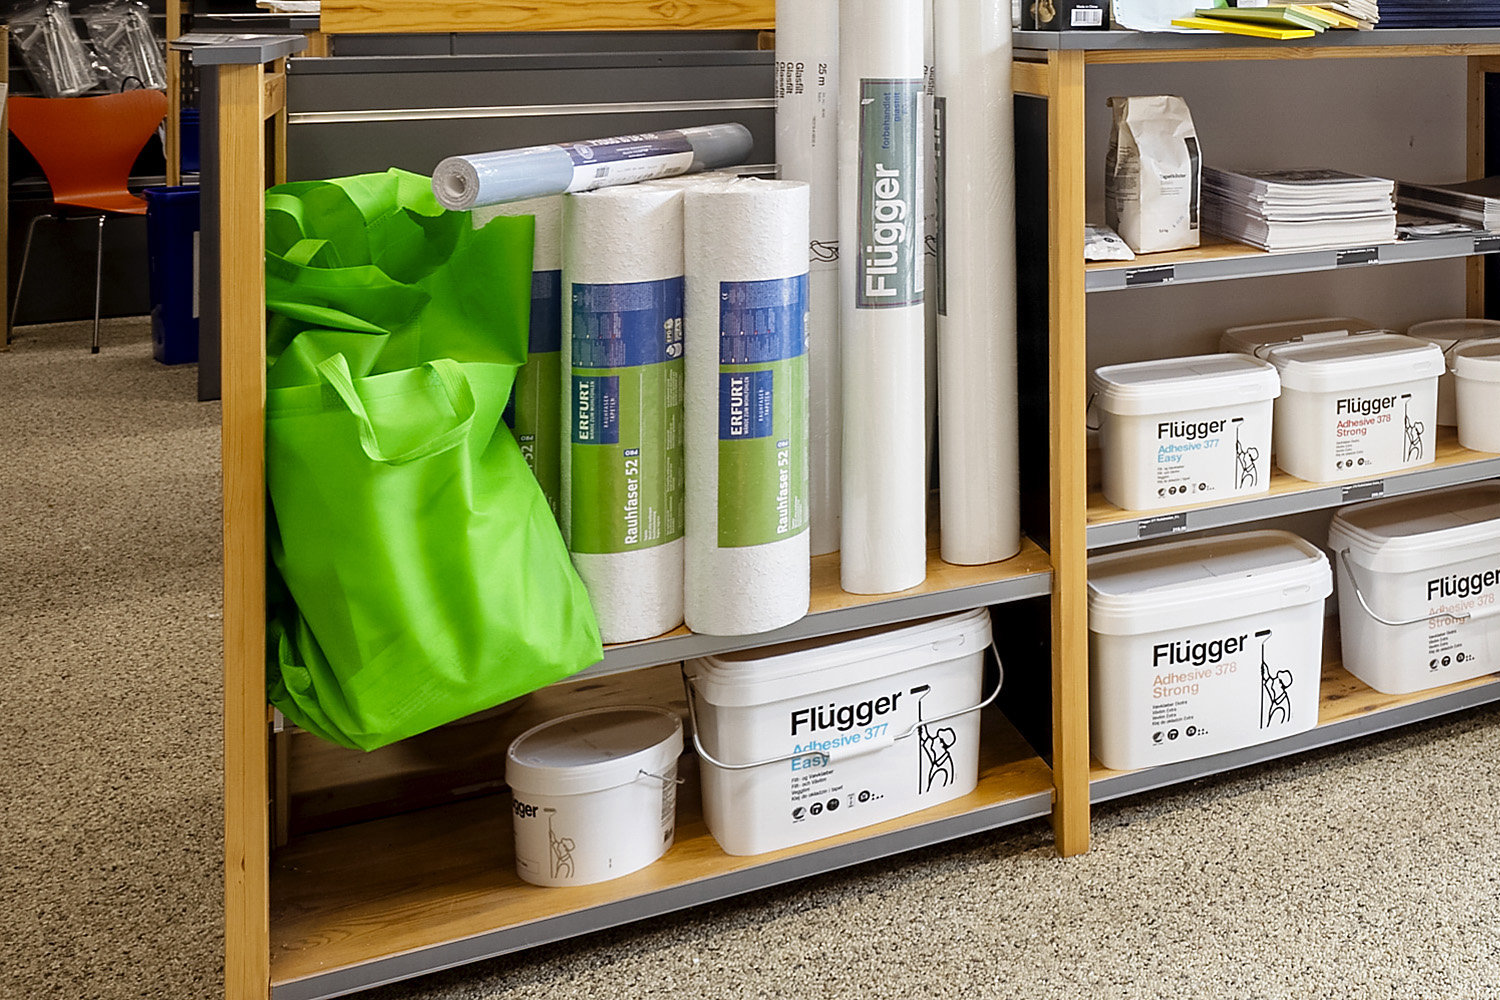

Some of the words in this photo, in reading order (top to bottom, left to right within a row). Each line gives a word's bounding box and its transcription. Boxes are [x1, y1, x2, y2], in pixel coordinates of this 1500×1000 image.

[796, 62, 805, 95] Glasfilt
[818, 63, 828, 75] 25
[865, 163, 907, 297] Flügger
[579, 381, 590, 440] ERFURT
[731, 377, 743, 436] ERFURT
[1336, 396, 1397, 416] Flügger
[1158, 419, 1227, 440] Flügger
[1336, 417, 1375, 429] Adhesive
[1377, 414, 1392, 424] 378
[1336, 427, 1367, 437] Strong
[1158, 442, 1202, 454] Adhesive
[1203, 439, 1220, 449] 377
[624, 459, 638, 476] 52
[777, 450, 789, 466] 52
[1157, 453, 1182, 463] Easy
[624, 478, 638, 545] Rauhfaser
[777, 469, 789, 534] Rauhfaser
[1477, 593, 1496, 607] 378
[1152, 633, 1249, 667] Flügger
[1152, 668, 1213, 687] Adhesive
[1215, 661, 1238, 676] 378
[1152, 683, 1200, 699] Strong
[791, 691, 903, 736] Flügger
[793, 733, 861, 755] Adhesive
[864, 722, 889, 740] 377
[791, 754, 830, 772] Easy
